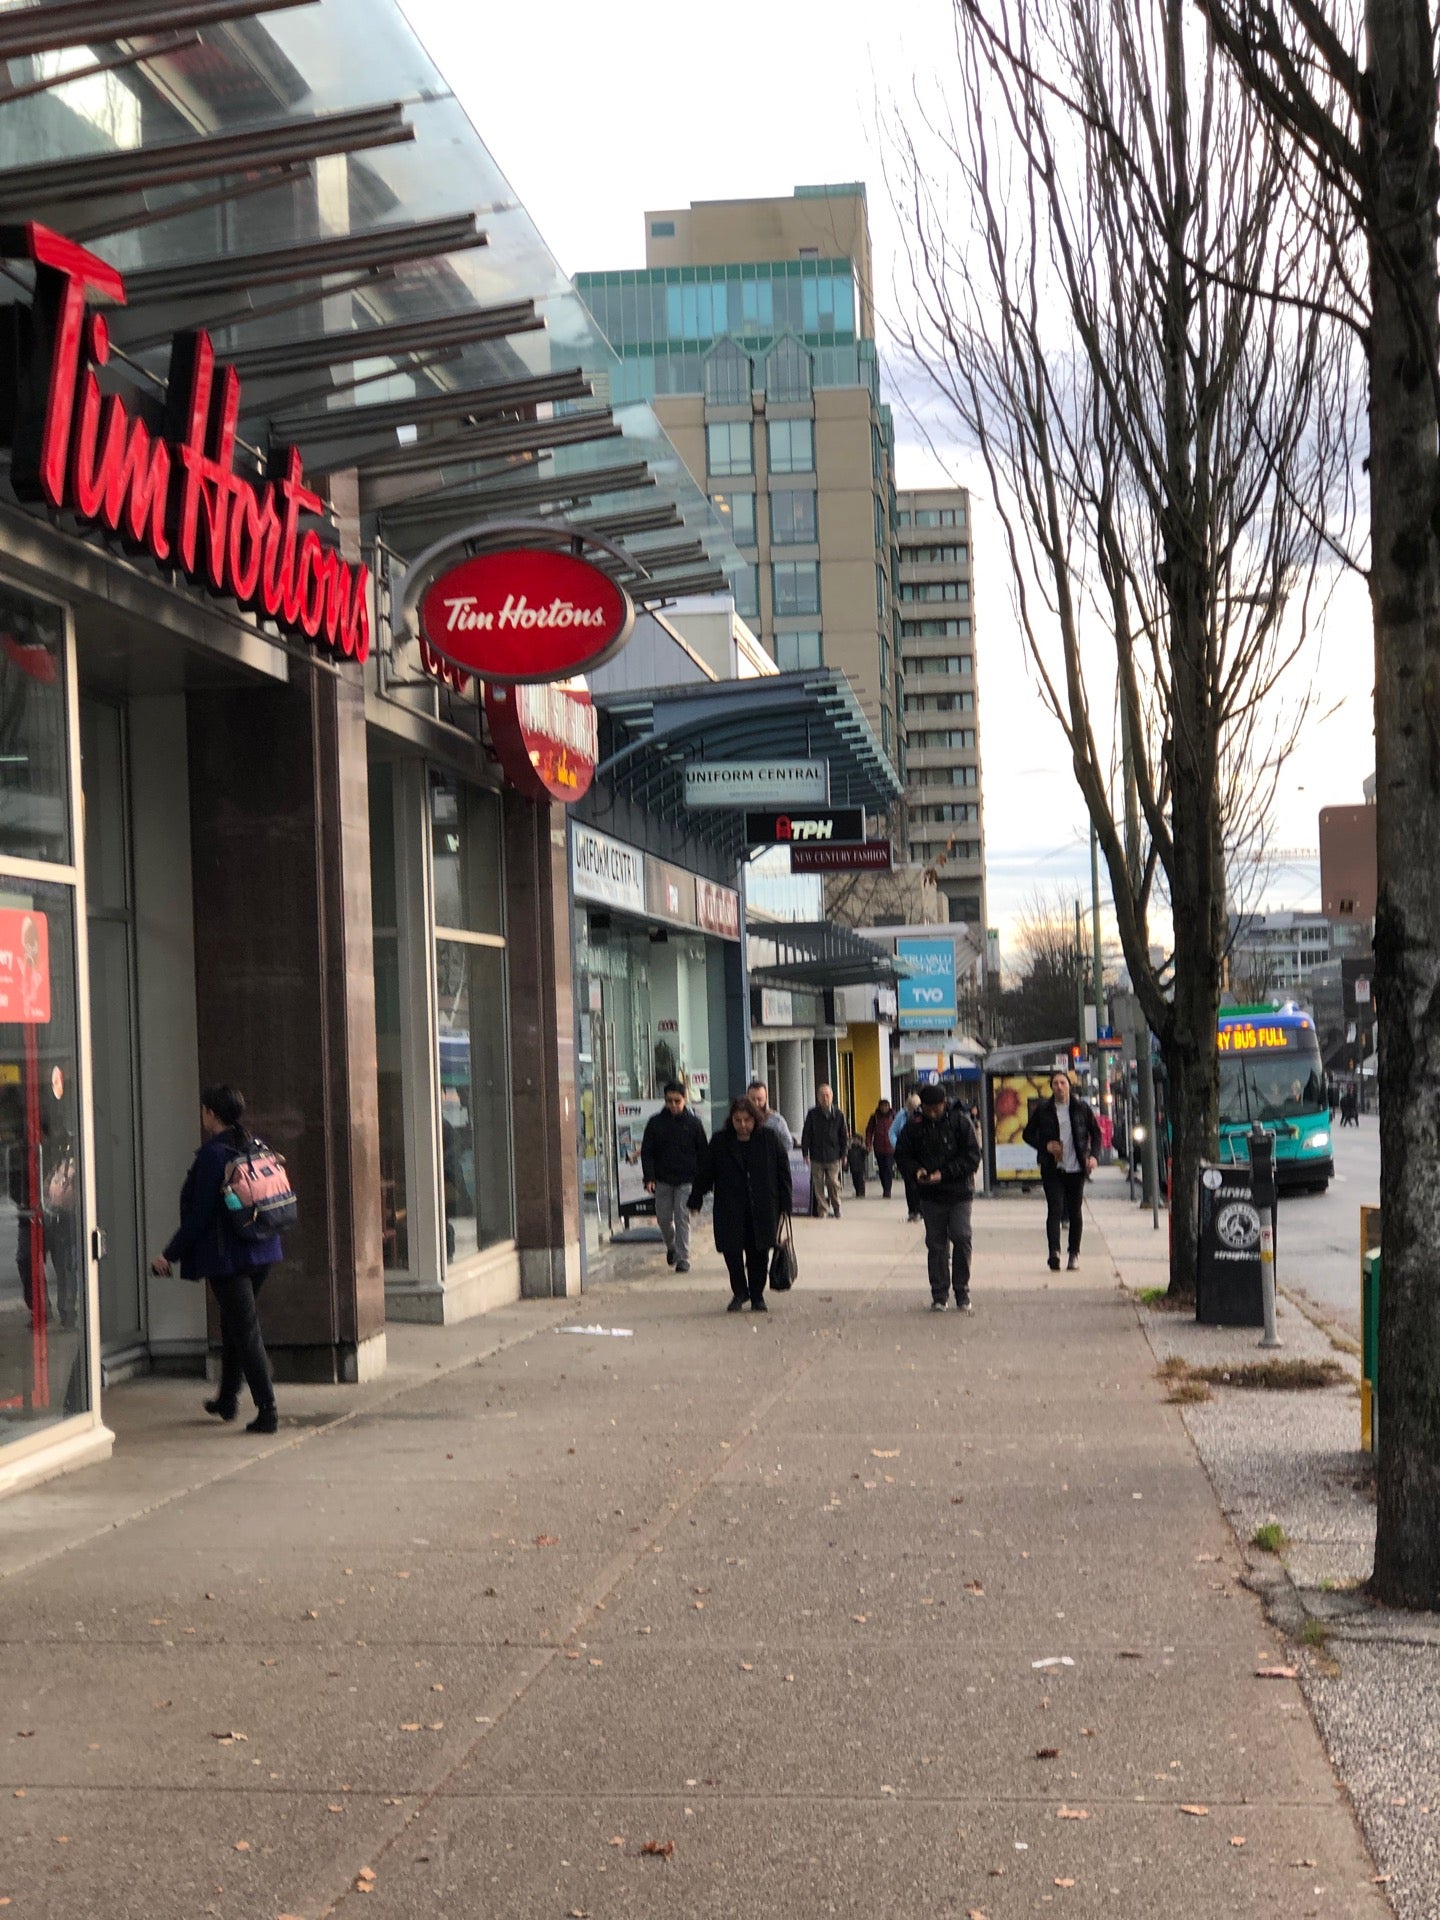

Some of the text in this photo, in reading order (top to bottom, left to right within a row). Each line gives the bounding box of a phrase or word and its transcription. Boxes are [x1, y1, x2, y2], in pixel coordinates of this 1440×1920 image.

[28, 221, 370, 665] Tim Hortons
[443, 593, 604, 632] Tim Hortons
[686, 766, 820, 784] UNIFORM CENTRAL
[790, 819, 834, 841] TPH
[575, 831, 640, 890] UNIFORM CENTRAL
[795, 848, 888, 864] NEW CENTURY FASHION
[912, 987, 944, 1003] TVO
[1233, 1029, 1257, 1050] BUS
[1258, 1027, 1288, 1048] FULL
